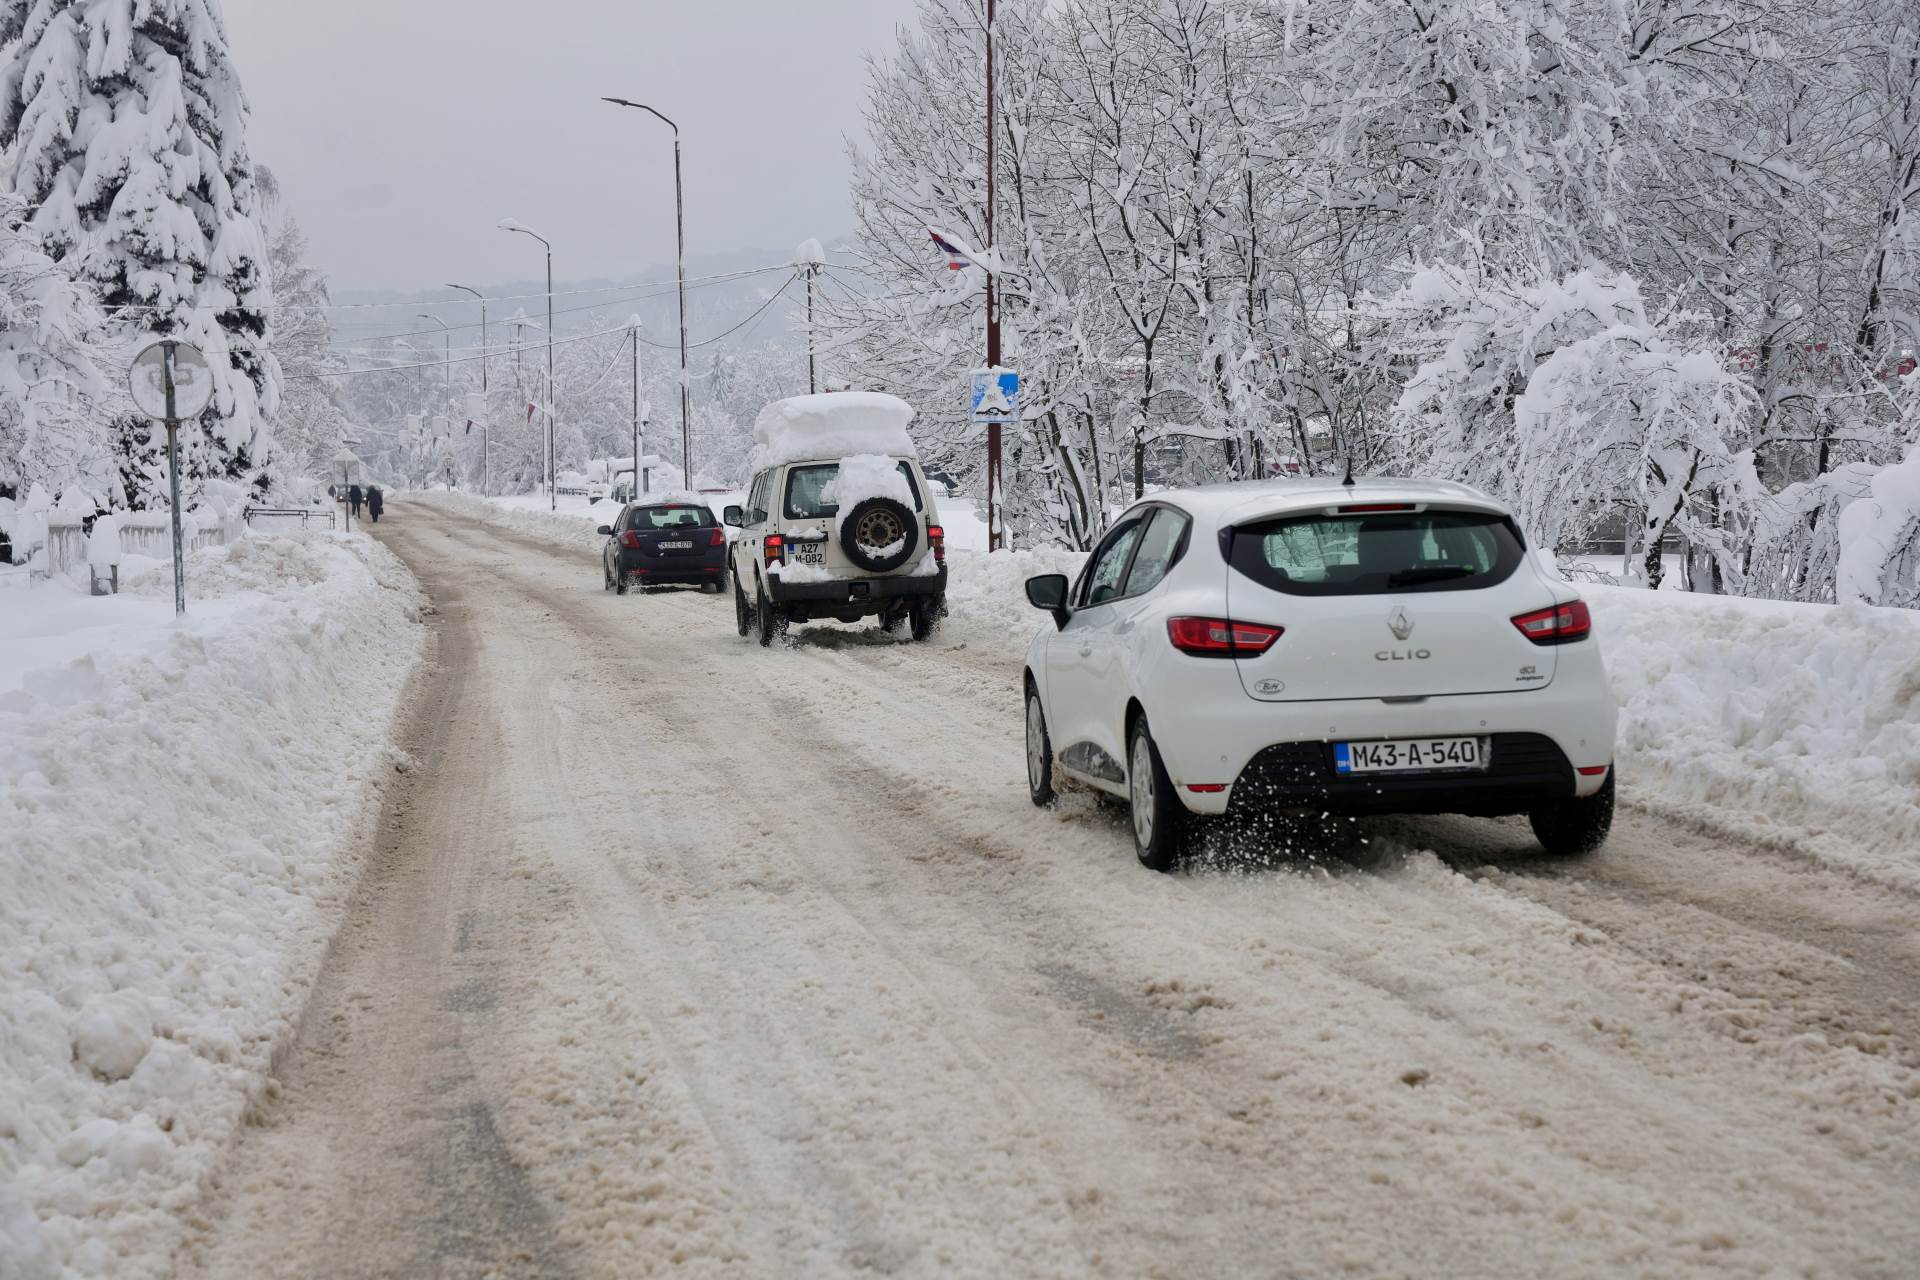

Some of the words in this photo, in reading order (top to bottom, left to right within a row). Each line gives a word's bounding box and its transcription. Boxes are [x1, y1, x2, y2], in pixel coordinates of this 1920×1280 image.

[801, 544, 818, 553] A27
[795, 554, 823, 564] M-082
[1375, 649, 1431, 661] CLIO
[1352, 741, 1476, 768] M43-A-540
